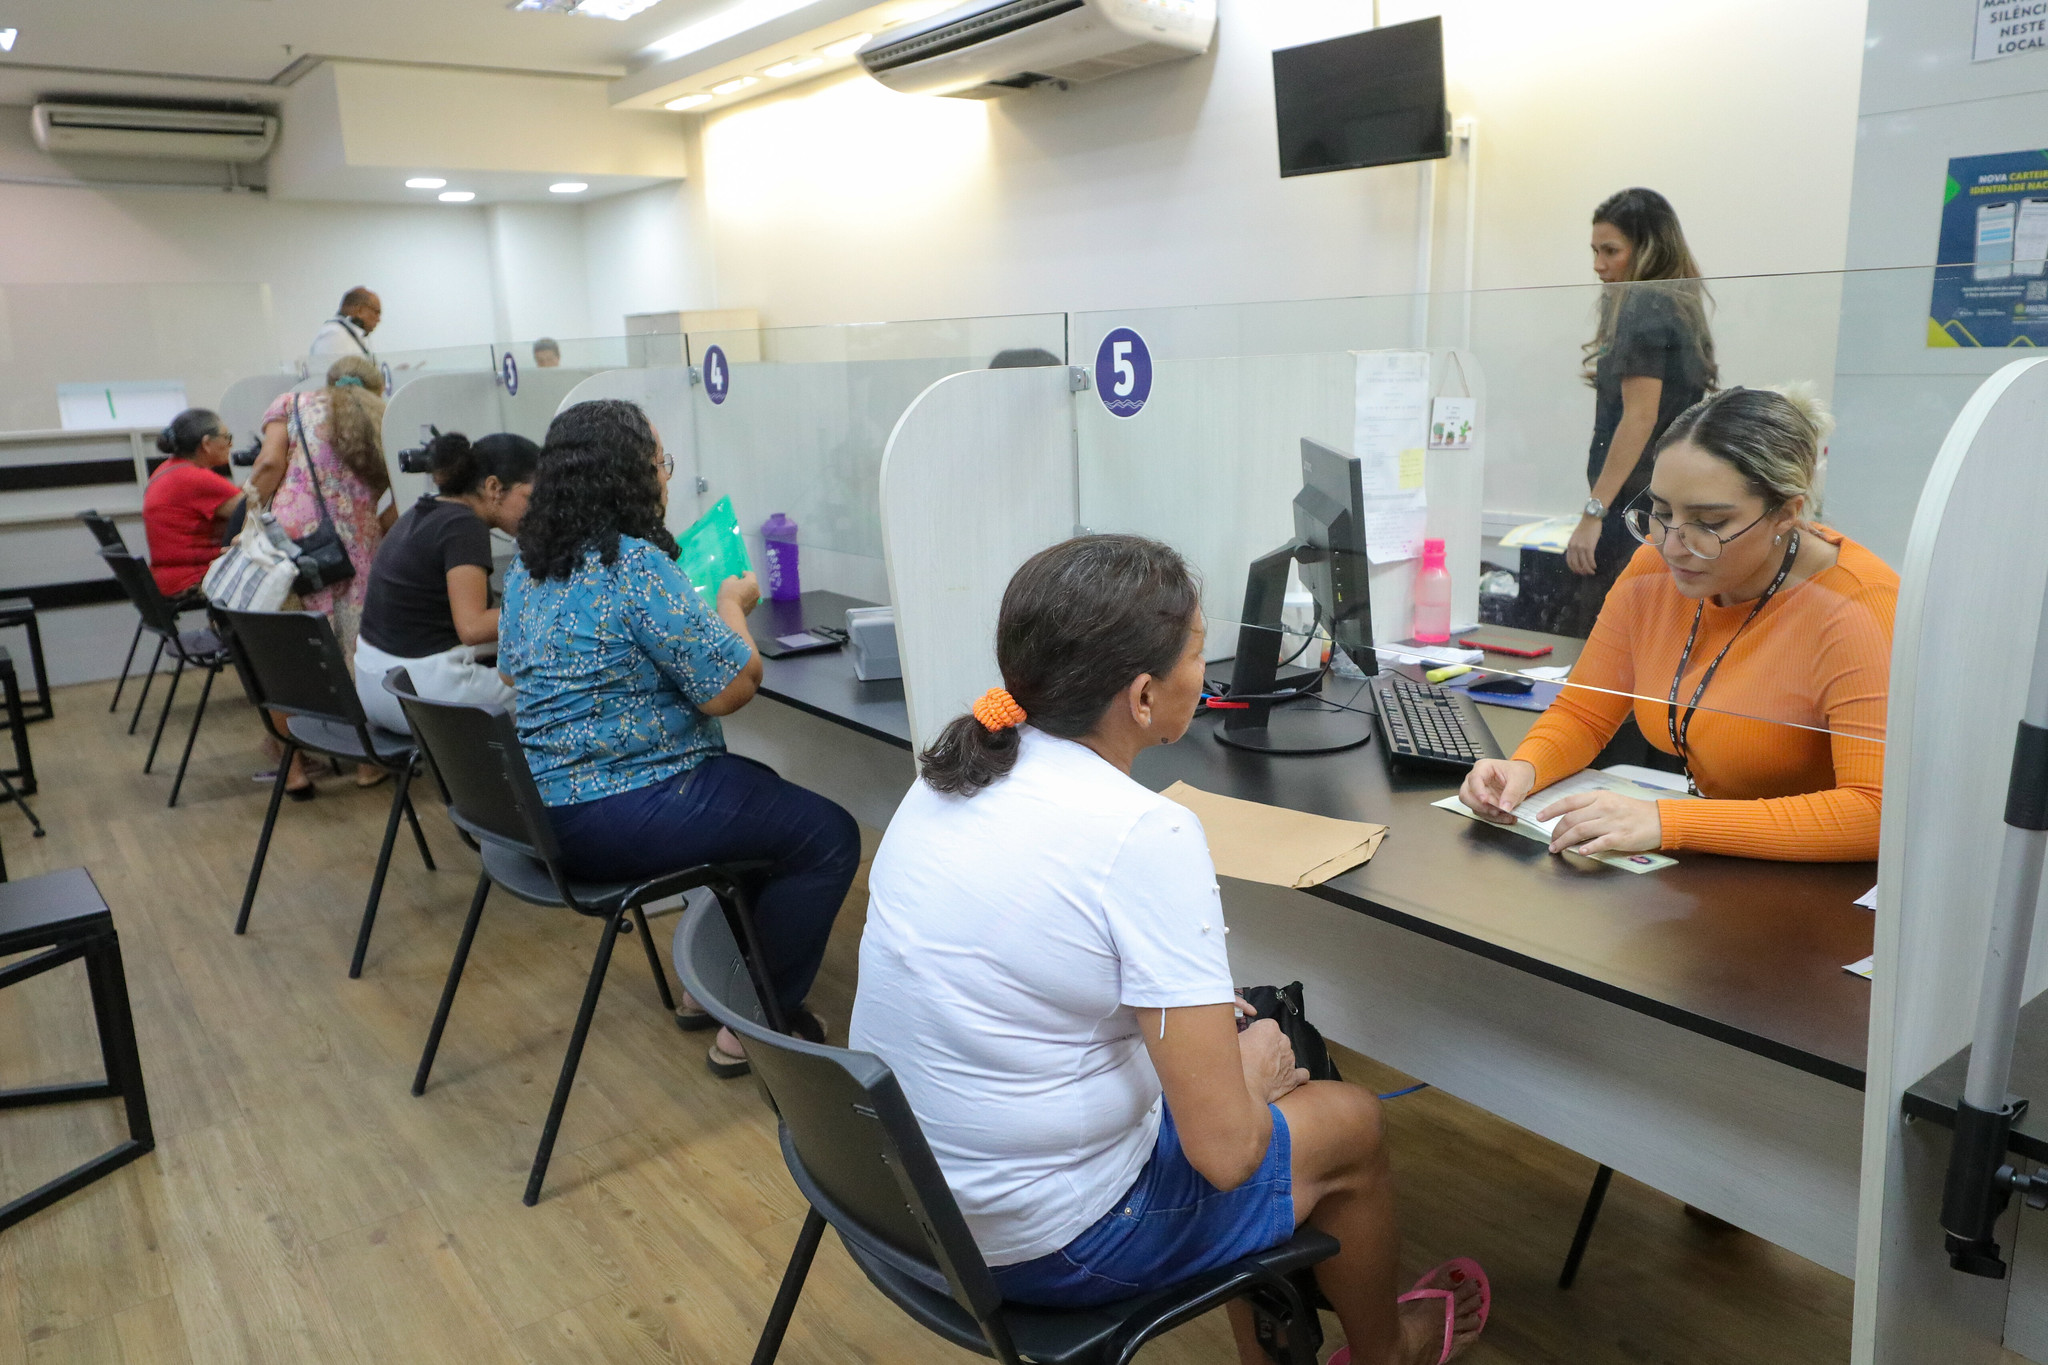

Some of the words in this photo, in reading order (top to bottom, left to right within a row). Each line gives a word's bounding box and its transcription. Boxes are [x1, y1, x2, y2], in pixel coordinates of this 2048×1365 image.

[2000, 20, 2046, 38] NESTE
[1998, 36, 2046, 54] LOCAL
[1978, 174, 2008, 184] NOVA
[1970, 182, 2026, 195] IDENTIDADE
[506, 358, 516, 386] 3
[710, 352, 723, 390] 4
[1114, 341, 1134, 396] 5
